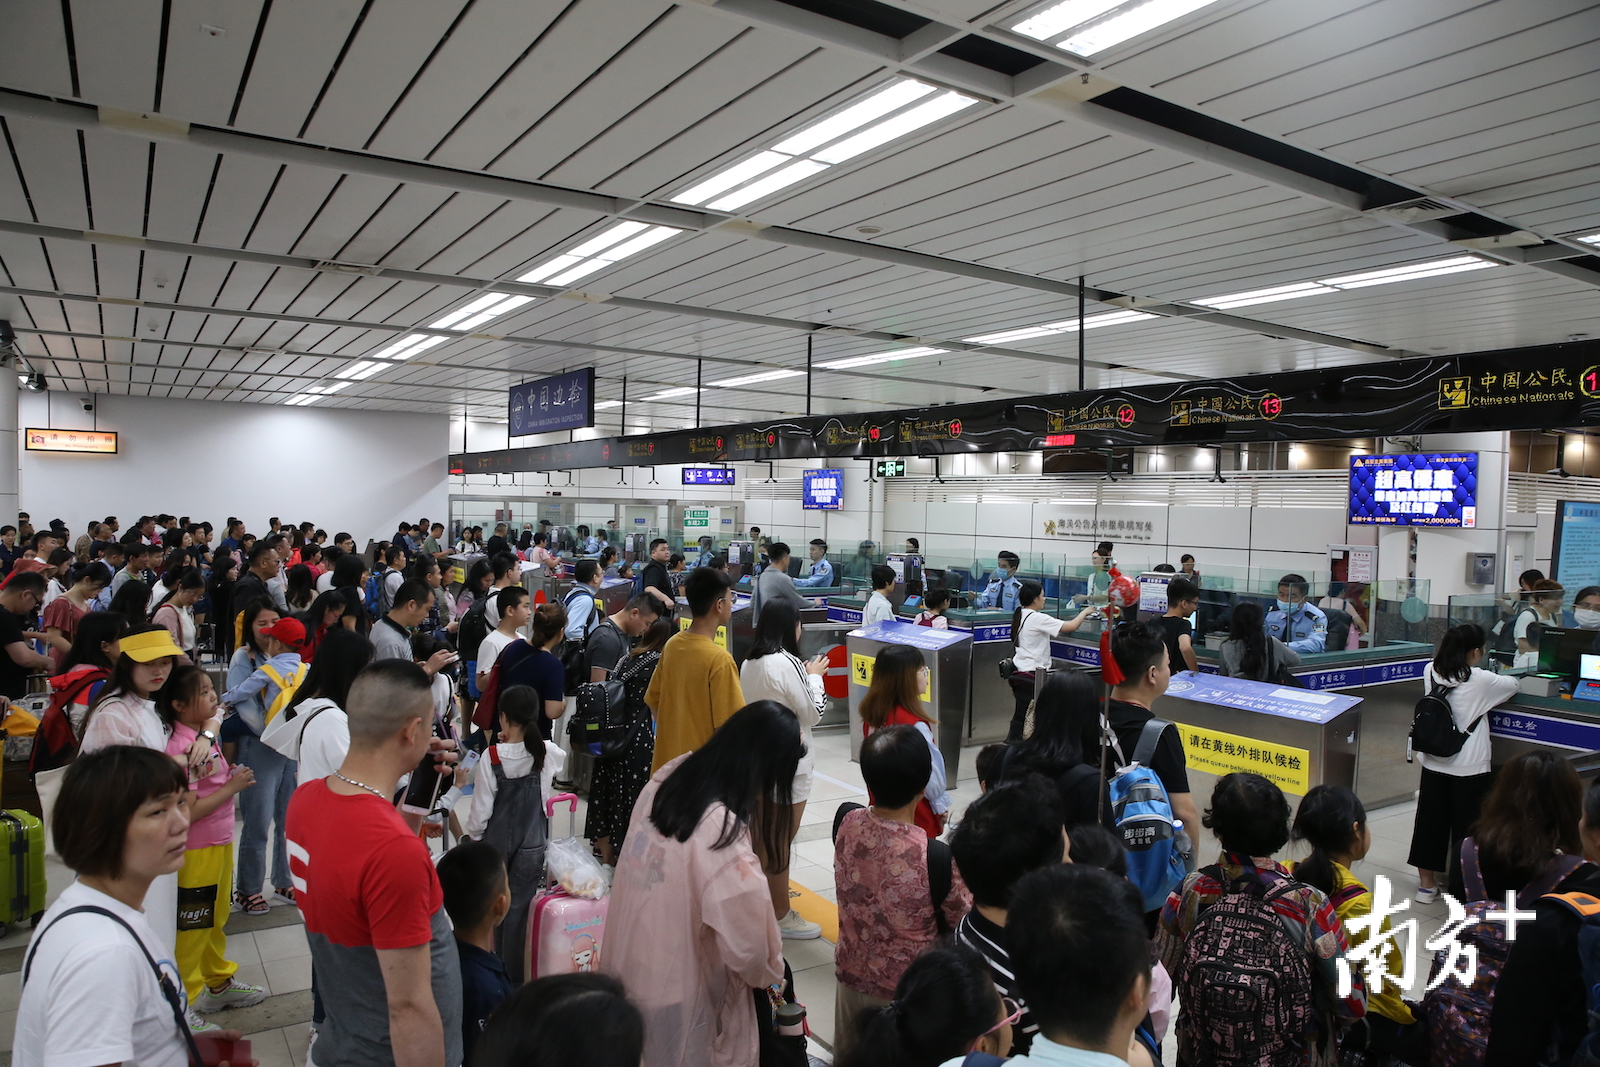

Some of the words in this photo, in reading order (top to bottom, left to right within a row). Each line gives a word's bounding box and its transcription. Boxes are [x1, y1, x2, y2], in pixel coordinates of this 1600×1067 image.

[1480, 368, 1573, 393] 中国公民
[527, 378, 583, 416] 中国边检
[1197, 395, 1255, 414] 中国公民
[1472, 395, 1517, 407] Chinese
[1520, 391, 1575, 404] Nationals
[1068, 405, 1114, 422] 中国公民
[1262, 398, 1280, 414] 13
[1120, 409, 1134, 422] 12
[1192, 415, 1220, 424] Chinese
[870, 428, 879, 439] 10
[951, 423, 960, 435] 11
[50, 433, 112, 444] 请勿拍照
[1320, 673, 1346, 684] 中国边检
[1223, 698, 1322, 720] 外国人出境卡填写处
[1233, 693, 1277, 704] Departure
[1299, 705, 1330, 714] Filling
[1493, 715, 1538, 731] 中国边检
[1189, 733, 1301, 771] 请在黄线外排队候检
[1190, 754, 1210, 764] Please
[1211, 760, 1229, 770] queue
[1230, 763, 1251, 773] behind
[1252, 768, 1264, 776] the
[1264, 771, 1286, 782] yellow
[1287, 776, 1300, 786] line
[1124, 826, 1156, 840] 步步高
[180, 908, 210, 920] Magic
